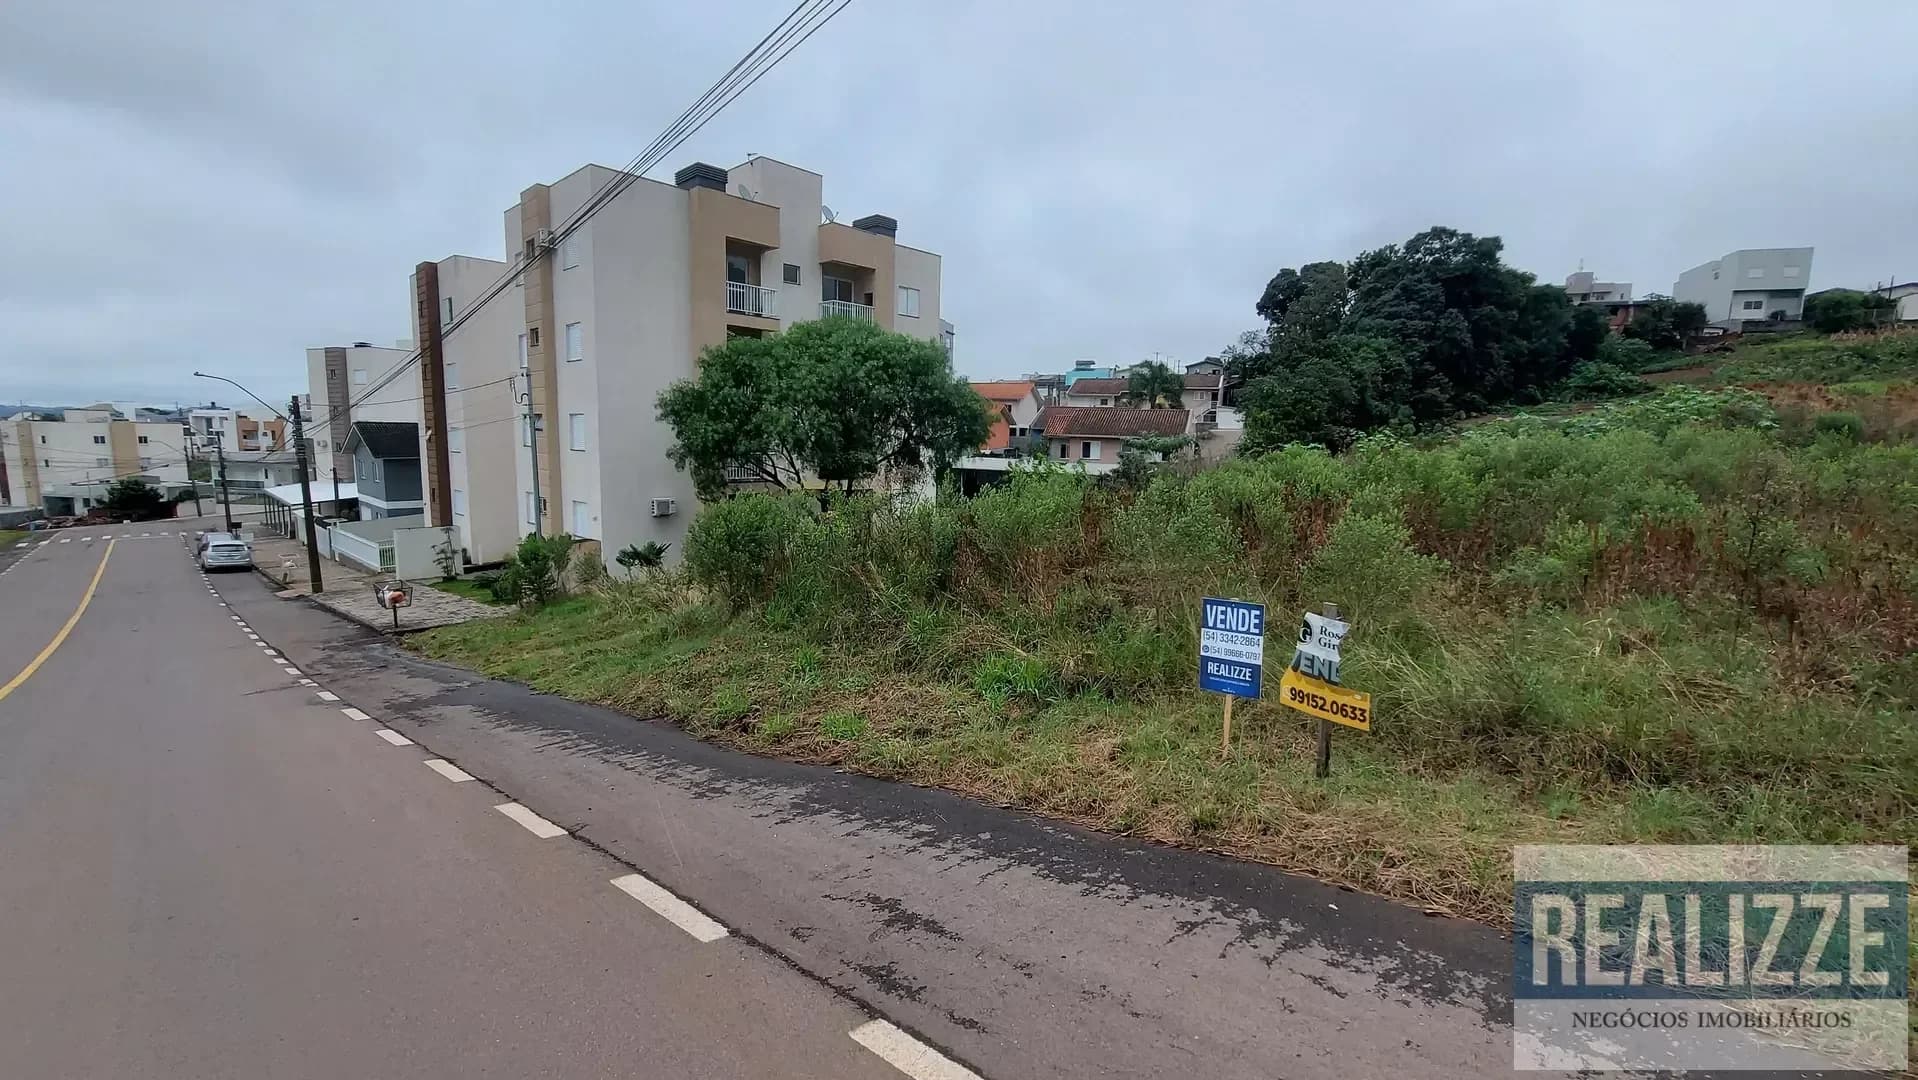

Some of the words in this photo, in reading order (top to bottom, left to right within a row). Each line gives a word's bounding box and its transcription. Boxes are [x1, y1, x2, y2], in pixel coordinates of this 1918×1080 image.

[1206, 604, 1260, 634] VENDE
[1219, 632, 1260, 648] 3342-2864
[1207, 661, 1253, 681] REALIZZE
[1289, 686, 1368, 723] 99152.0633
